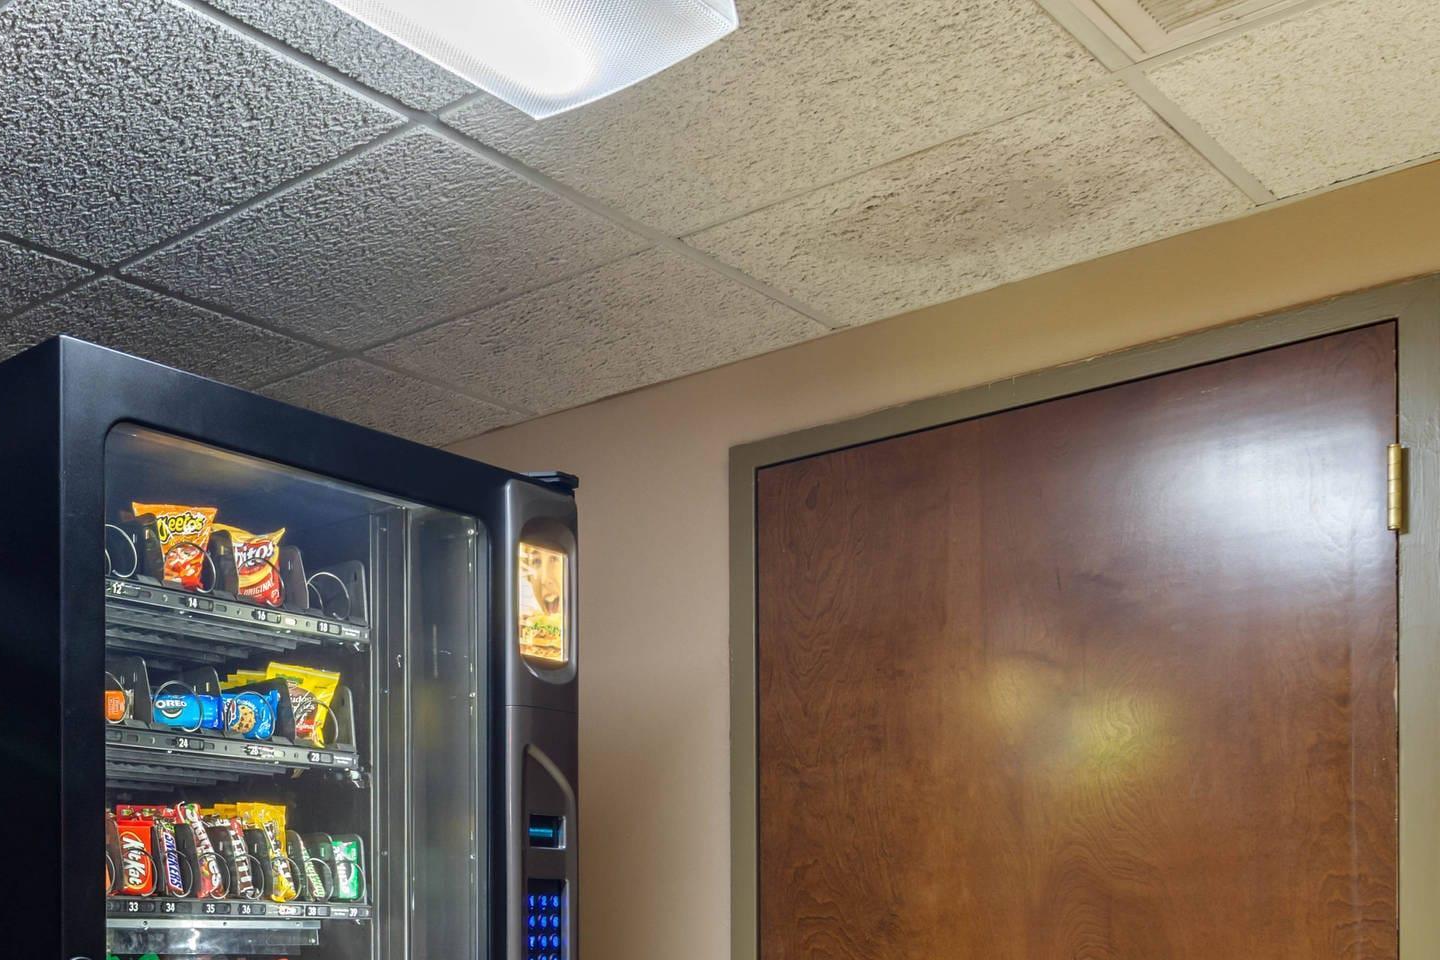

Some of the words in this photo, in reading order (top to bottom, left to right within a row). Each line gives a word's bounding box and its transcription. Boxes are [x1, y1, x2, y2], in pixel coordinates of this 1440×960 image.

[155, 699, 188, 709] OREO
[178, 738, 189, 748] 24
[128, 902, 139, 912] 33
[165, 902, 176, 912] 34
[206, 904, 216, 913] 35
[241, 905, 251, 914] 36
